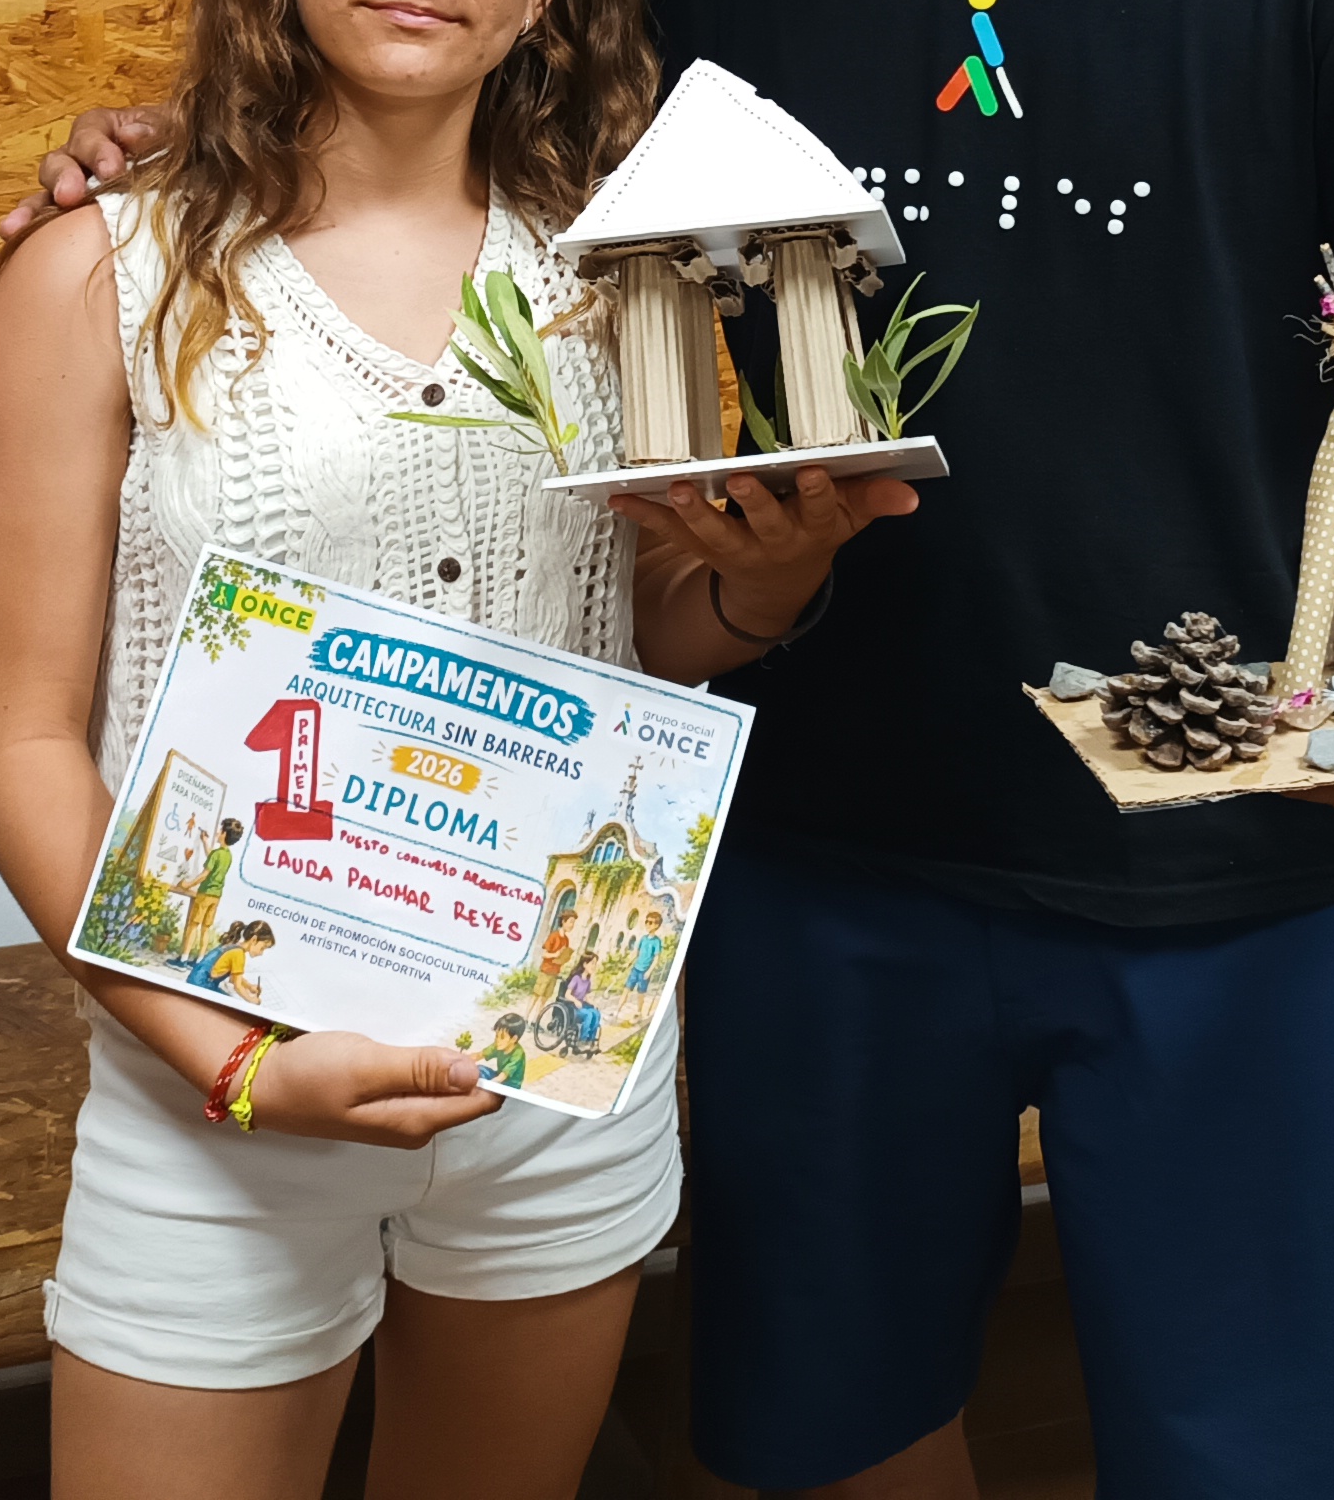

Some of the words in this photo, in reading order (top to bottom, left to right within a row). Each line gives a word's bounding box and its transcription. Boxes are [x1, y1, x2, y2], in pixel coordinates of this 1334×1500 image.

[240, 594, 313, 631] ONCE
[327, 634, 579, 739] CAMPAMENTOS
[285, 674, 436, 736] ARQUITECTURA
[441, 722, 477, 747] SIN
[483, 733, 584, 780] BARRERAS
[638, 724, 711, 760] ONCE
[642, 709, 678, 732] grupo
[680, 720, 715, 739] social
[406, 750, 465, 787] 2026
[341, 774, 499, 851] DIPLOMA
[339, 829, 390, 855] PUESTO
[263, 846, 333, 883] LAURA
[347, 866, 435, 914] PALOMAR
[453, 900, 523, 943] REYES
[247, 898, 309, 926] DIRECCIÓN
[310, 918, 327, 931] DE
[328, 924, 397, 954] PROMOCIÓN
[300, 932, 357, 959] ARTÍSTICA
[359, 950, 369, 962] Y
[369, 954, 432, 983] DEPORTIVA
